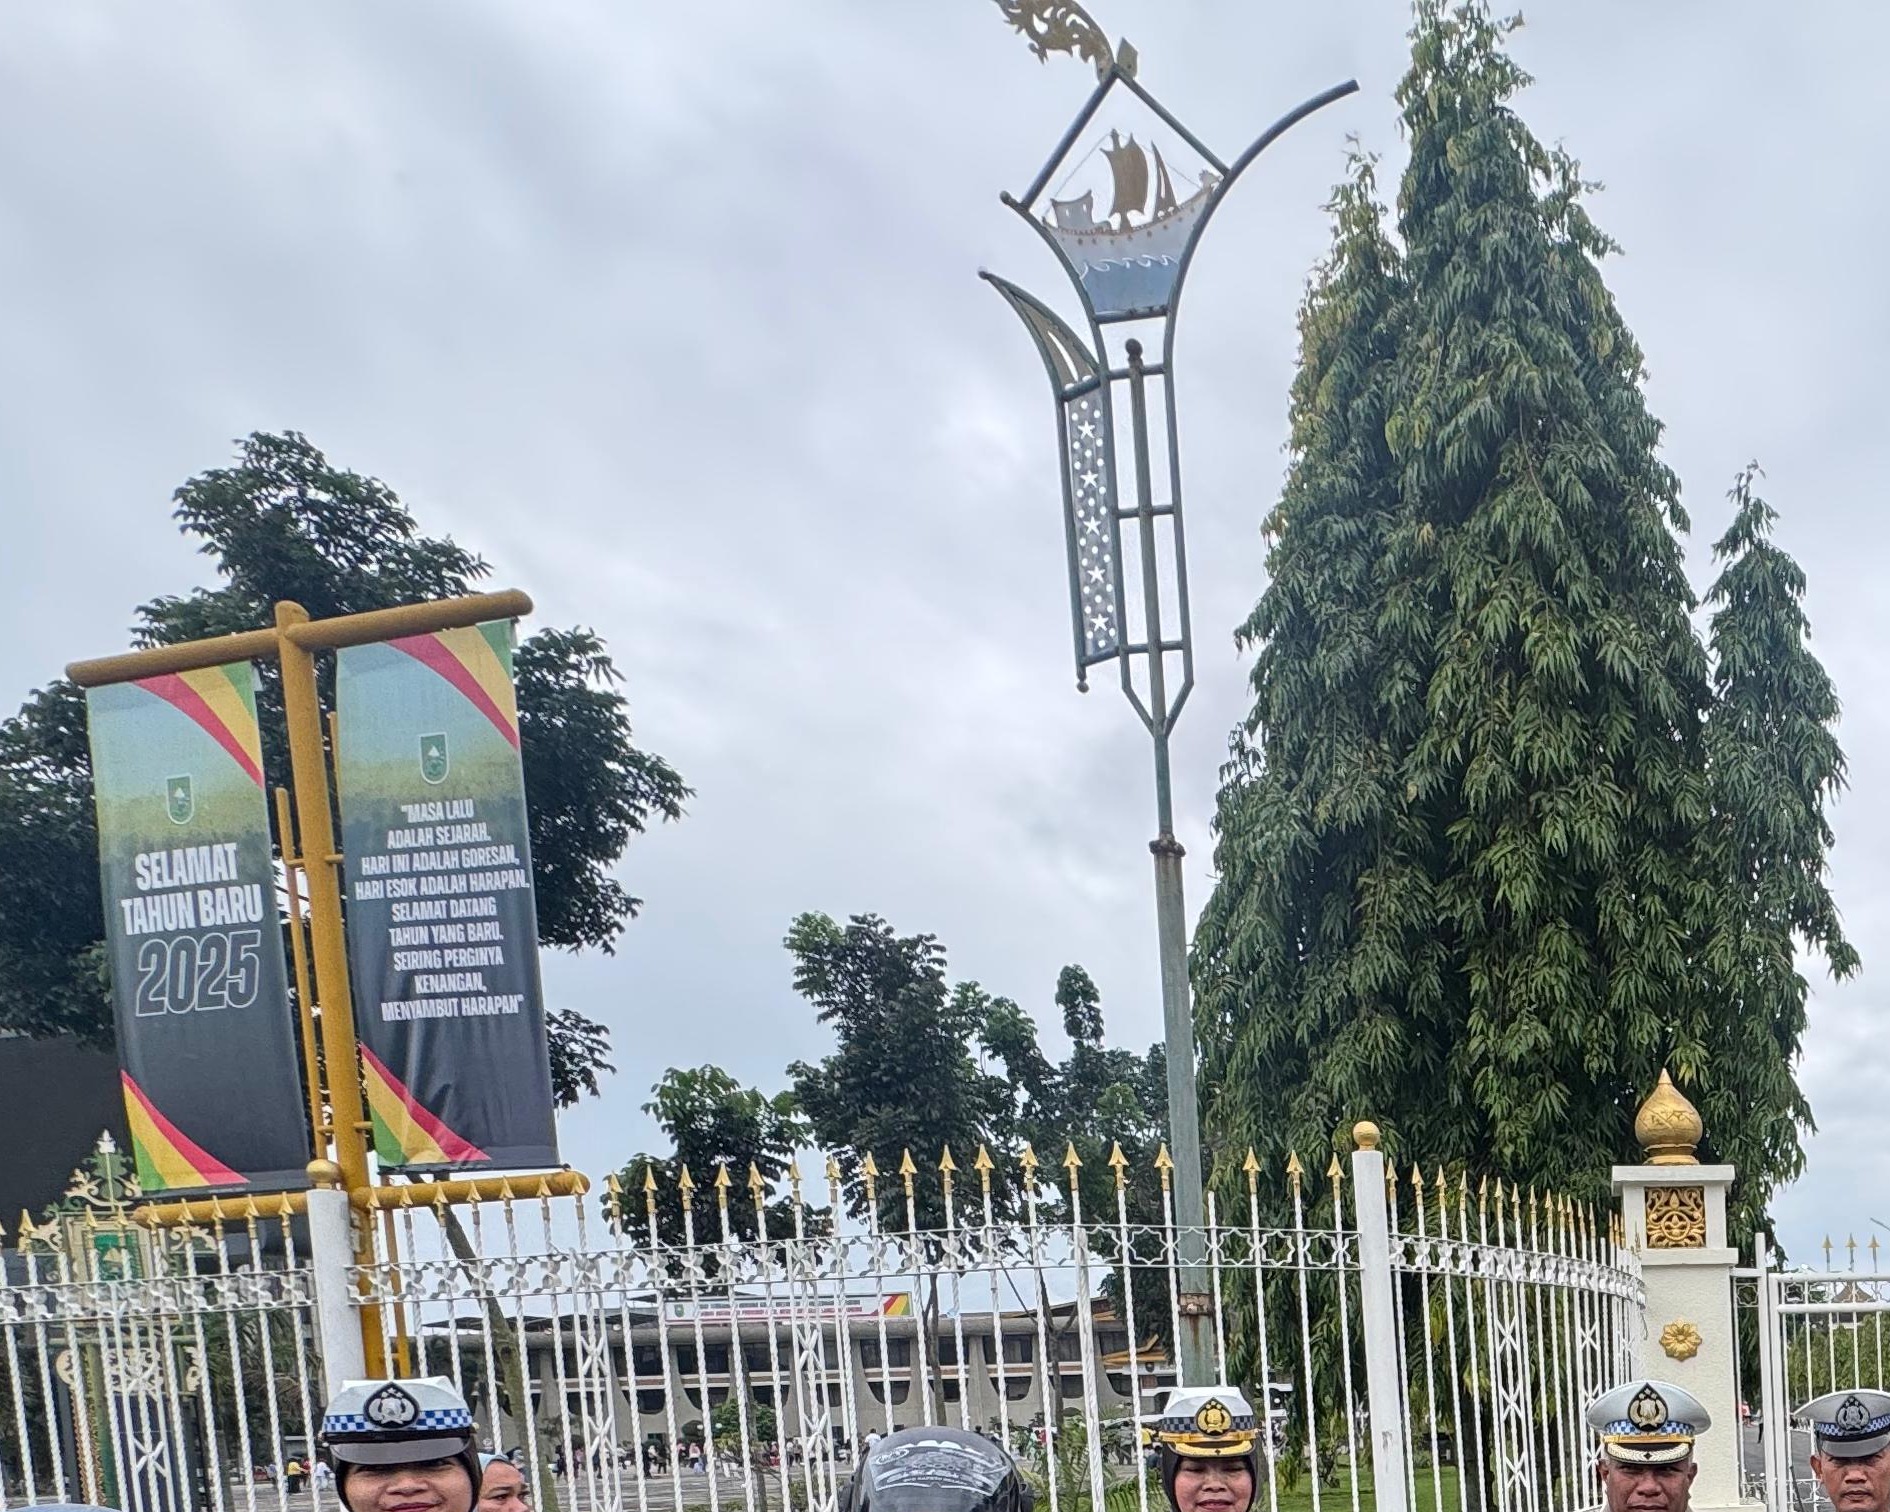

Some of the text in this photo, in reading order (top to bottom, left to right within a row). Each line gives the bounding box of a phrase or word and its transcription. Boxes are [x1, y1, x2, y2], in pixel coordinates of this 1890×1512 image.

[445, 799, 475, 820] LALU
[387, 822, 491, 849] ADALAH SEJARAH.
[135, 843, 238, 891] SELAMAT
[361, 844, 520, 876] HARI INI ADALAH GORESAN,
[354, 869, 531, 900] HARI ESOK ADALAH HARAPAN.
[121, 884, 264, 935] TAHUN BARU
[392, 897, 498, 923] SELAMAT DATANG
[389, 921, 504, 947] TAHUN YANG BARU.
[393, 946, 504, 971] SEIRING PERGINYA
[136, 930, 261, 1017] 2025
[414, 972, 488, 994] KENANGAN,
[381, 998, 459, 1021] MENYAMBUT
